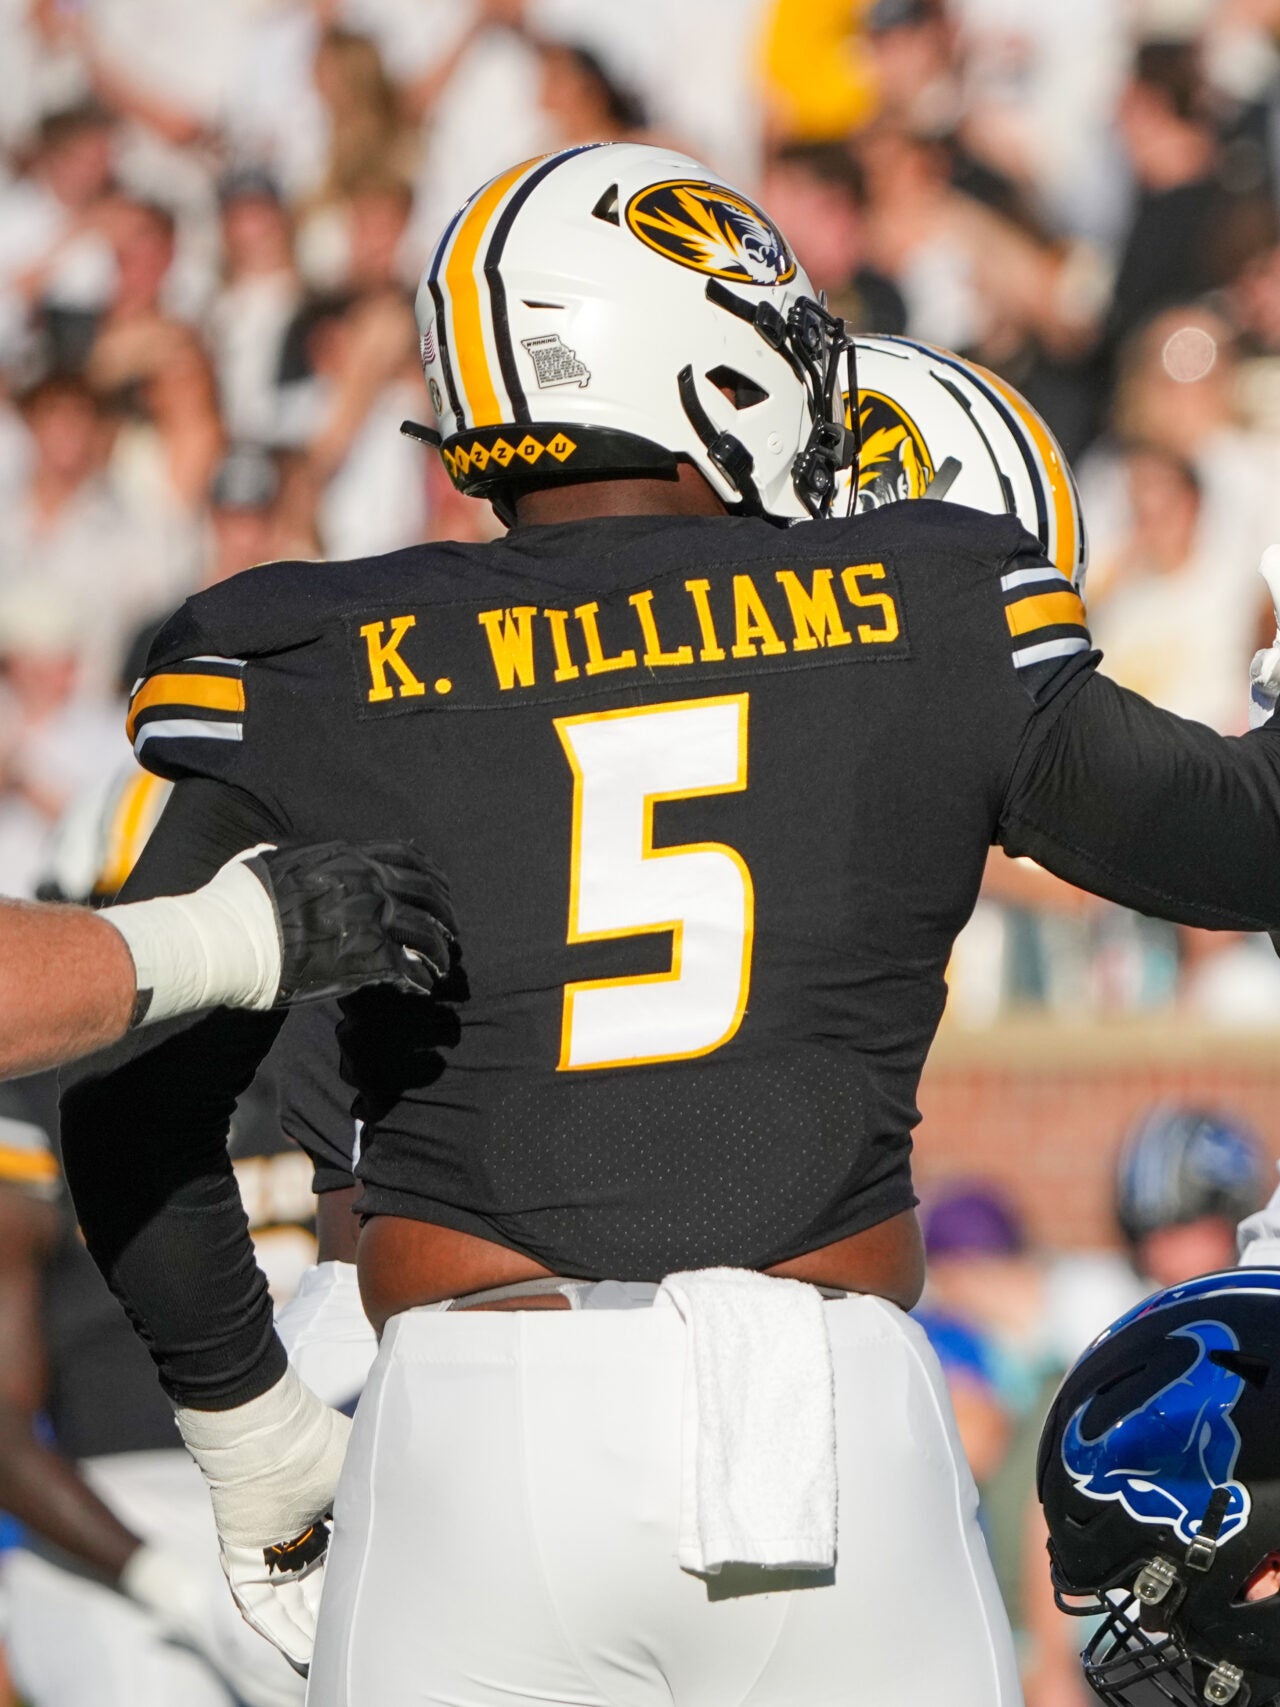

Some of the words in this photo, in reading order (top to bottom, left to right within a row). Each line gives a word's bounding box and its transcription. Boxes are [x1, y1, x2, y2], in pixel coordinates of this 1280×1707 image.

[445, 440, 569, 470] IZZOU
[360, 615, 453, 702] K.
[478, 563, 900, 691] WILLIAMS
[553, 692, 755, 1072] 5
